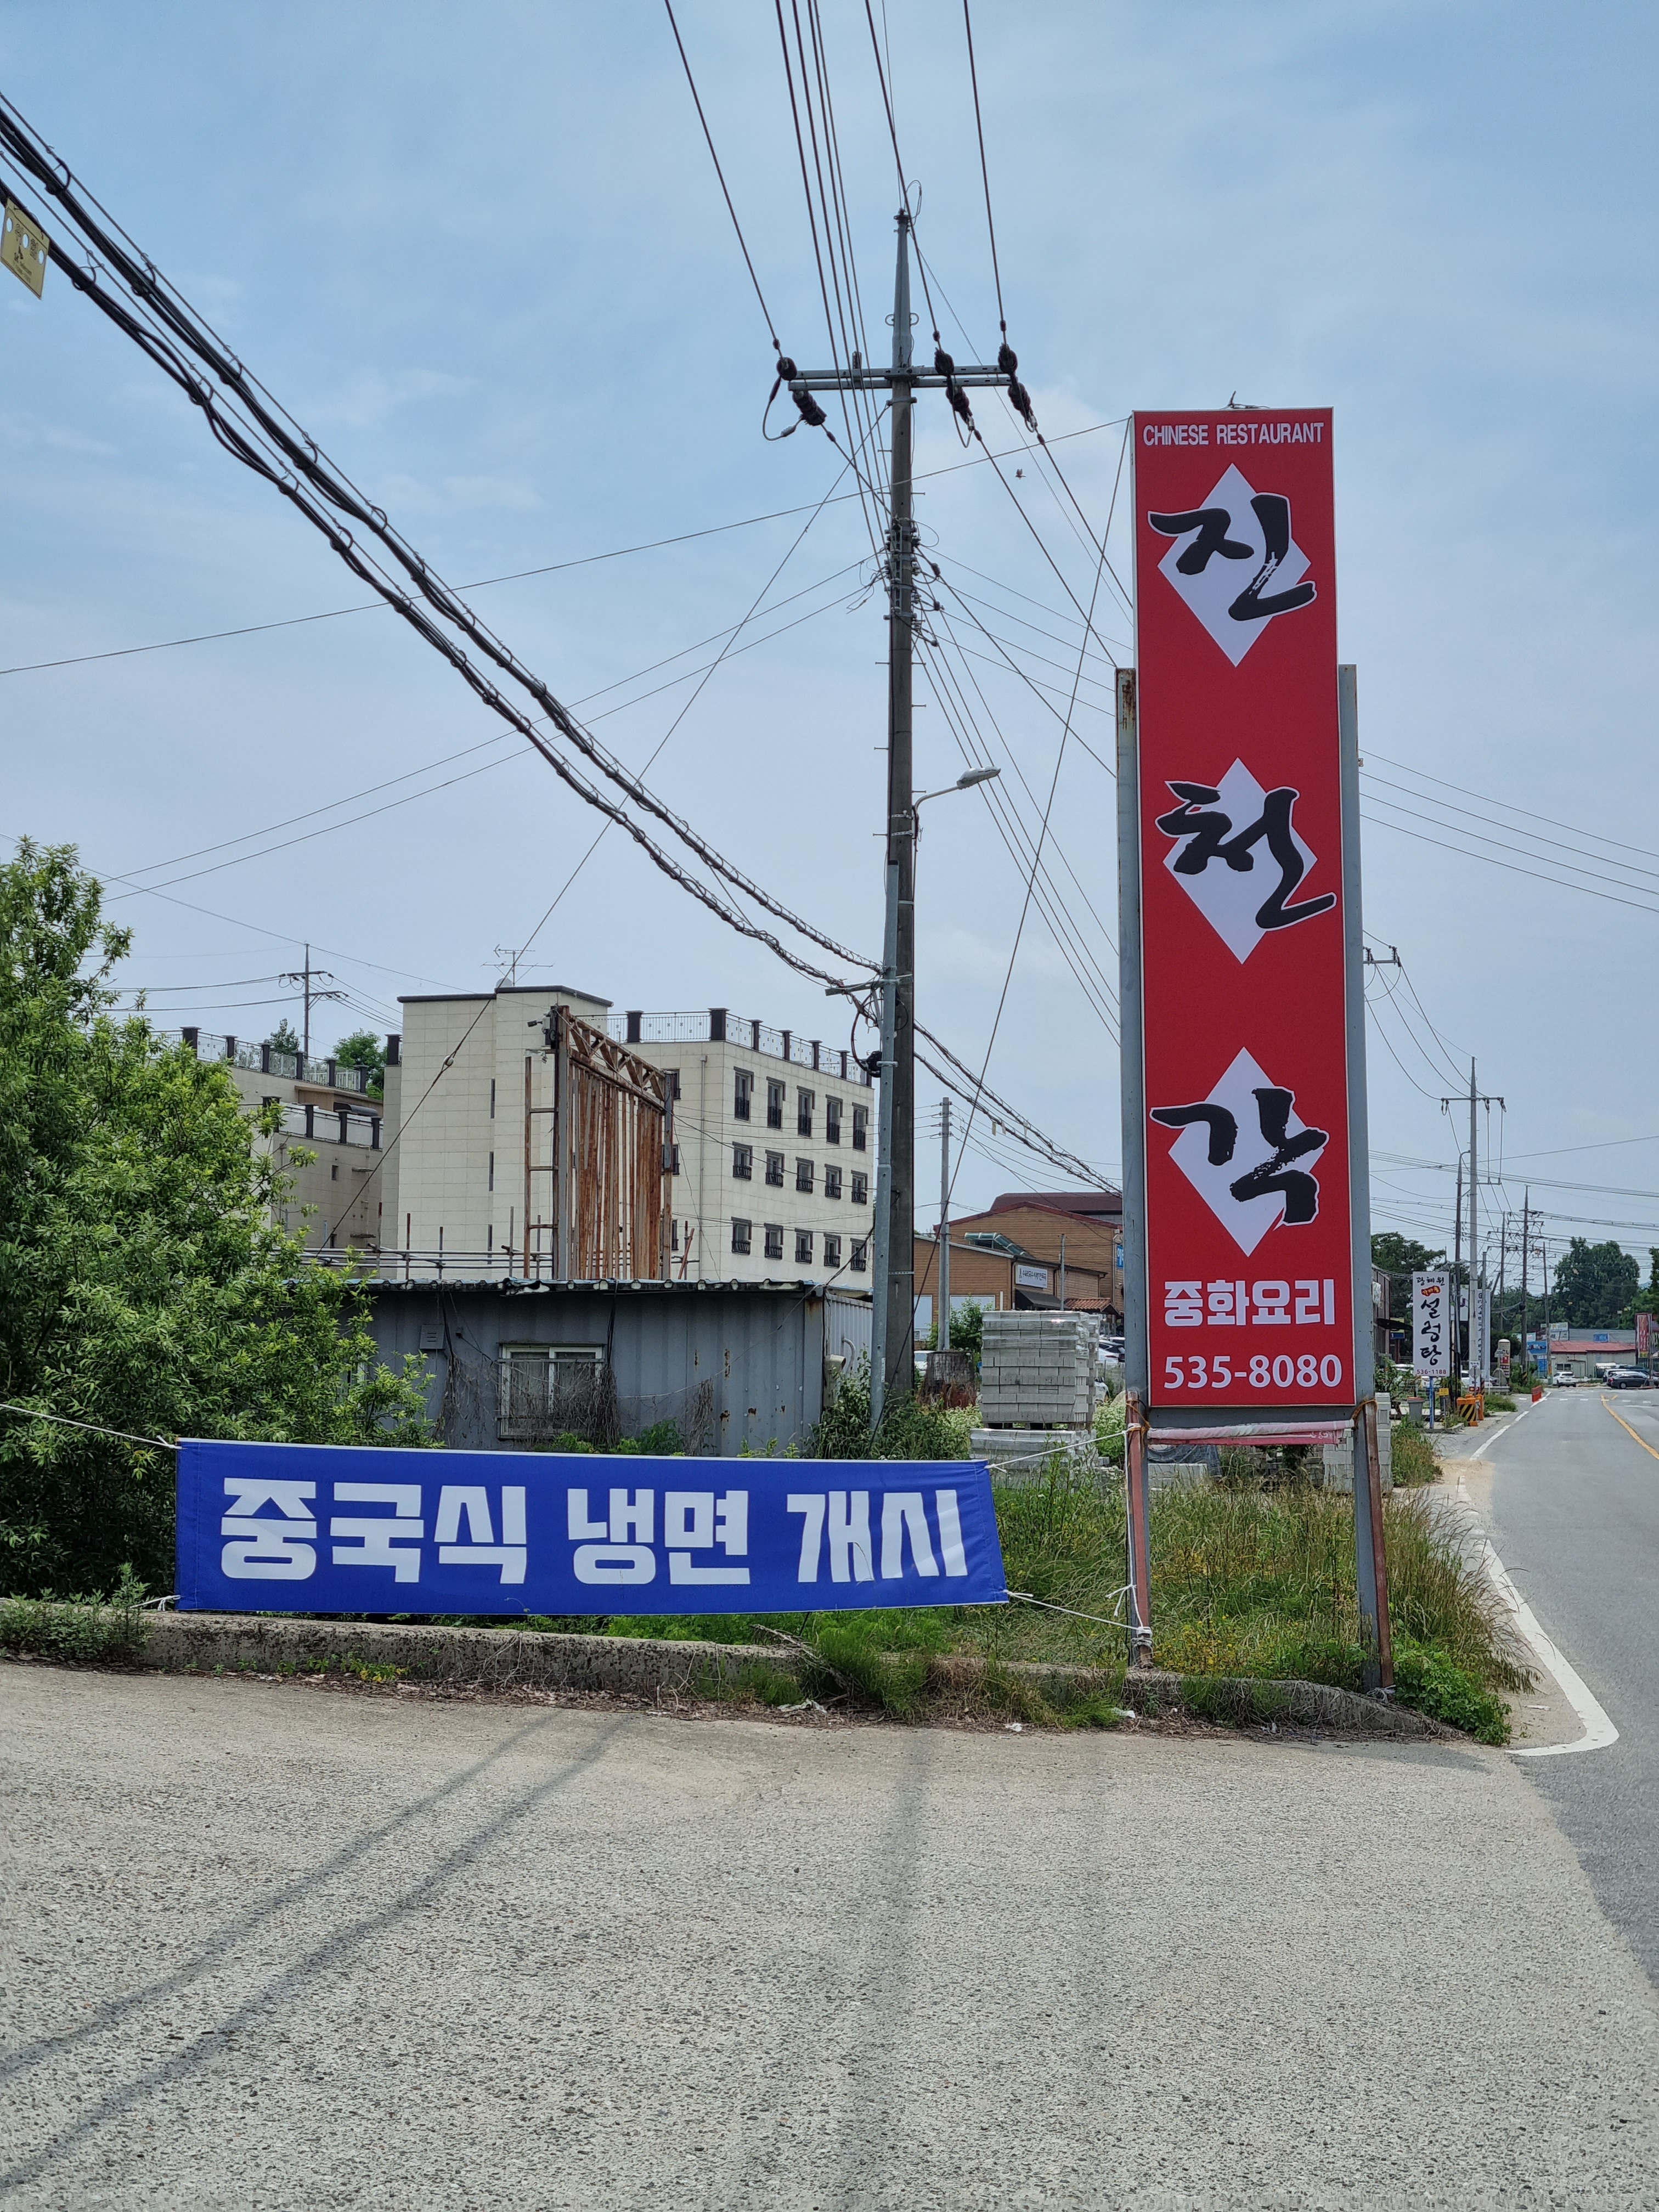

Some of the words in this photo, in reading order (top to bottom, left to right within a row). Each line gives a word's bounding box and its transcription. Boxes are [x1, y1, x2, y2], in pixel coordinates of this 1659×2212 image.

[1143, 425, 1209, 446] CHINESE
[1216, 422, 1324, 445] RESTAURANT
[1148, 493, 1336, 1226] 진천각
[1164, 1279, 1335, 1327] 중화요리
[1416, 1277, 1445, 1286] 광혜원
[1420, 1297, 1442, 1365] 설렁탕
[1164, 1354, 1342, 1389] 535-8080
[221, 1477, 527, 1584] 중국식
[567, 1488, 751, 1585] 냉면
[787, 1489, 968, 1583] 개시
